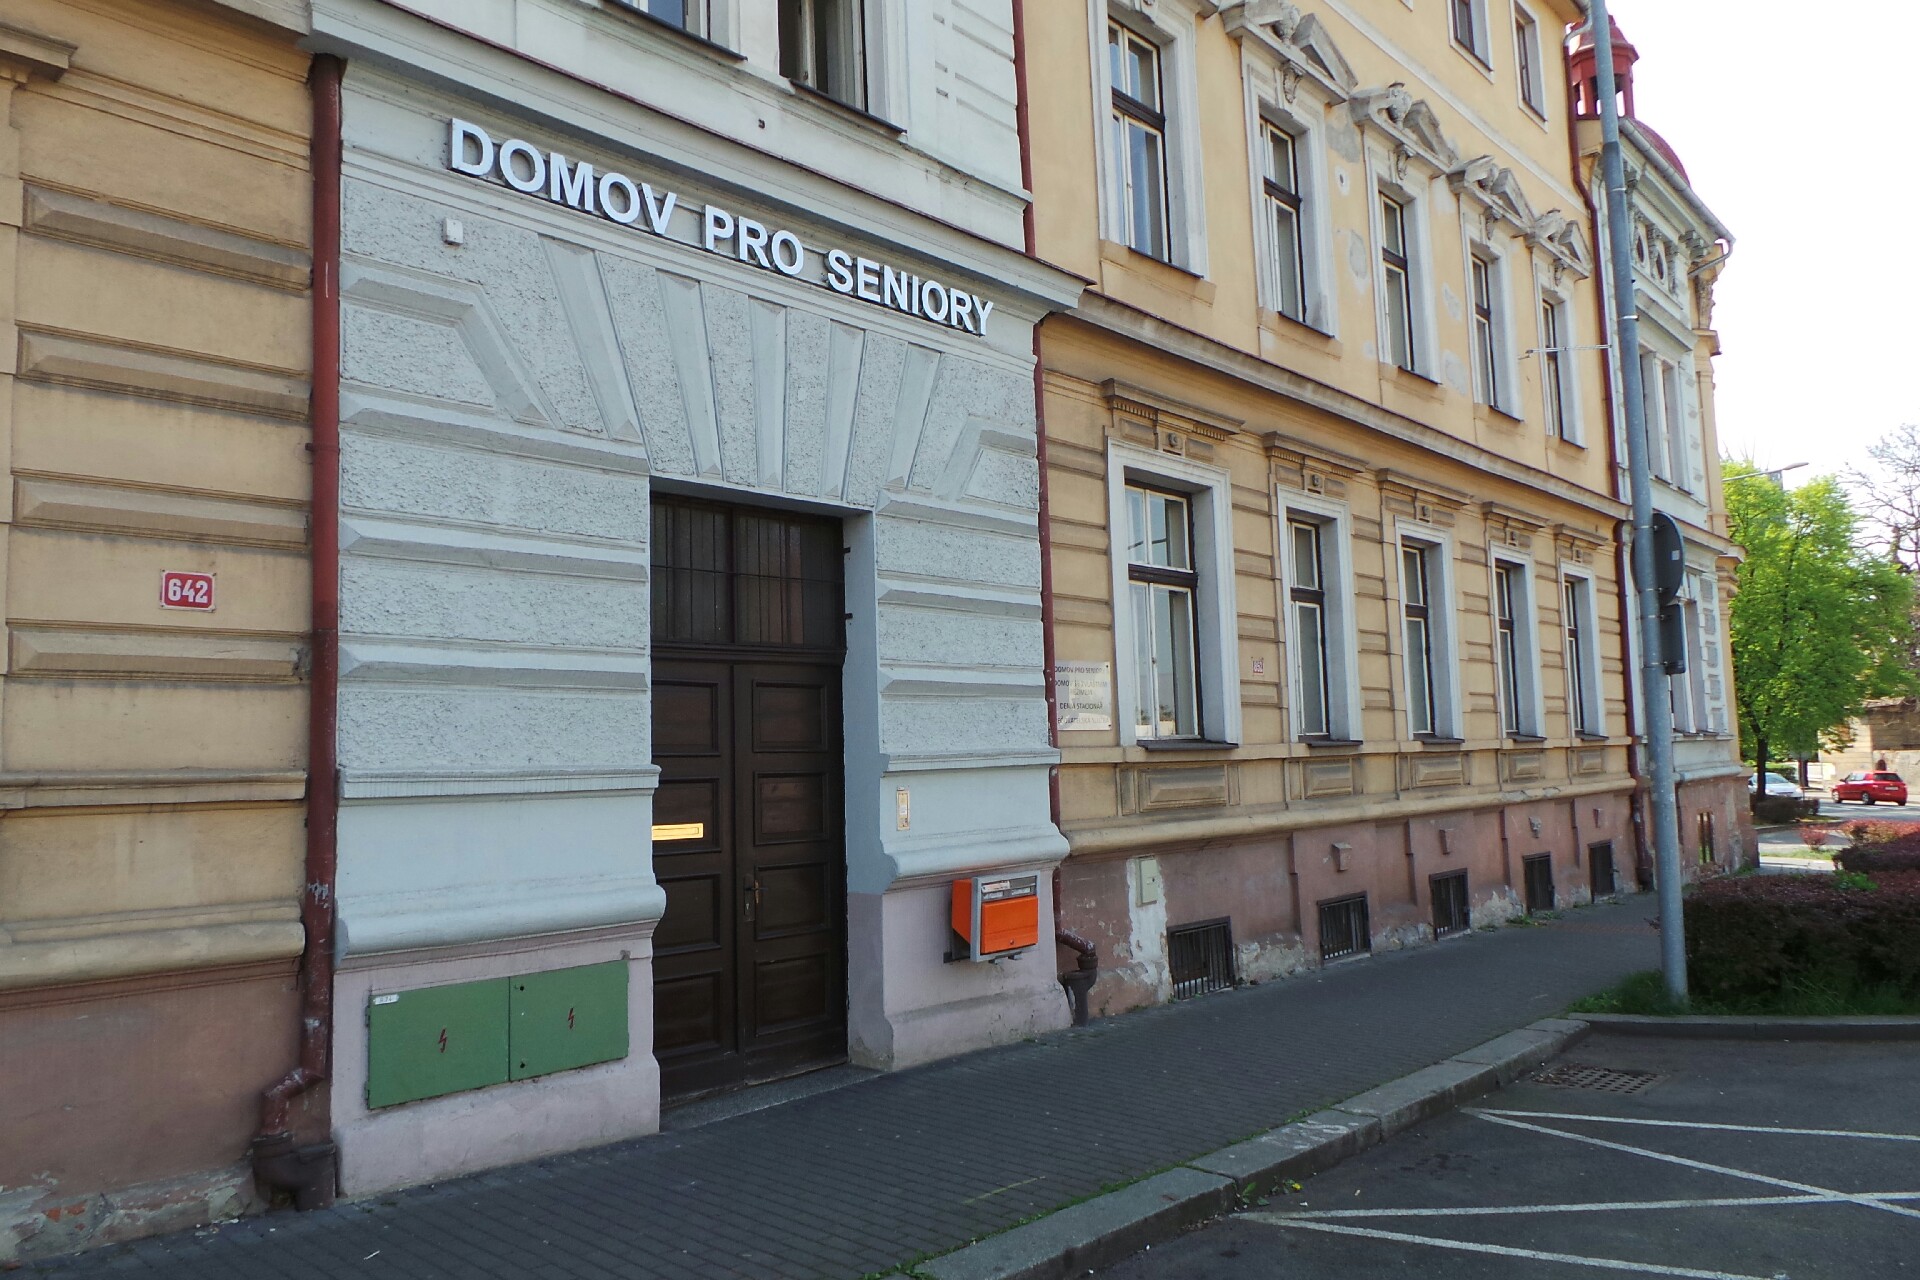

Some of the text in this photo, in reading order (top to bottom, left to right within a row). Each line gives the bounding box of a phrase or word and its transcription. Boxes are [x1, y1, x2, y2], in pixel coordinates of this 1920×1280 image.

[451, 117, 994, 336] DOMOV PRO SENIORY
[168, 578, 208, 604] 642
